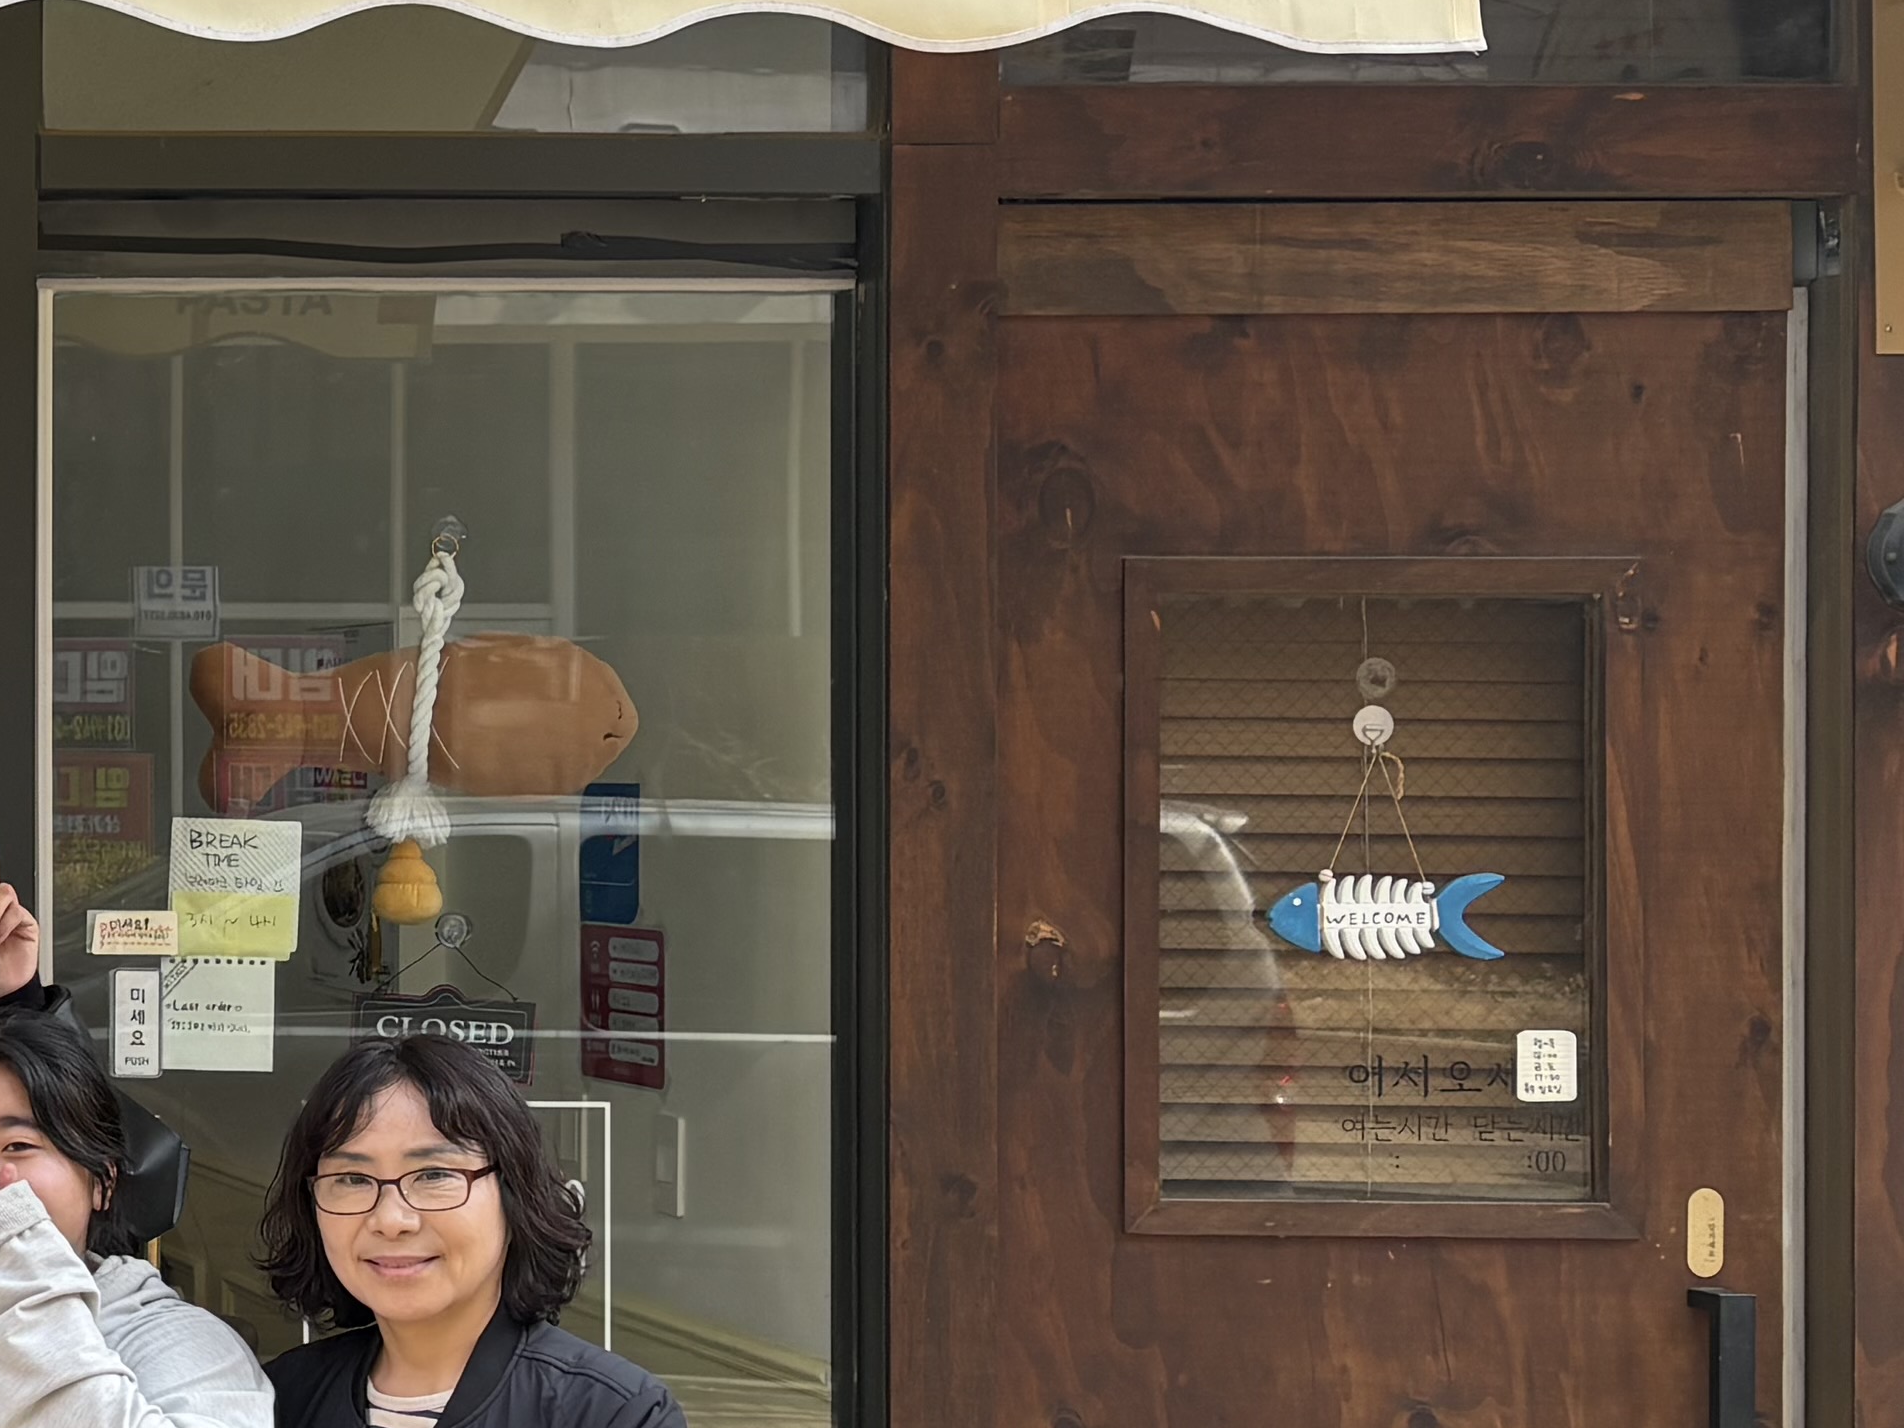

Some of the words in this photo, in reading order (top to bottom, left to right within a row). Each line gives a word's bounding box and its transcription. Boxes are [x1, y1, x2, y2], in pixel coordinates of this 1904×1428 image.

[190, 829, 258, 850] BREAK
[202, 853, 240, 868] TIME
[1326, 912, 1427, 926] WELCOME
[130, 988, 146, 1047] 미세요
[376, 1015, 515, 1045] CLOSED
[125, 1056, 149, 1066] PUSH
[1342, 1113, 1452, 1142] 여는시간
